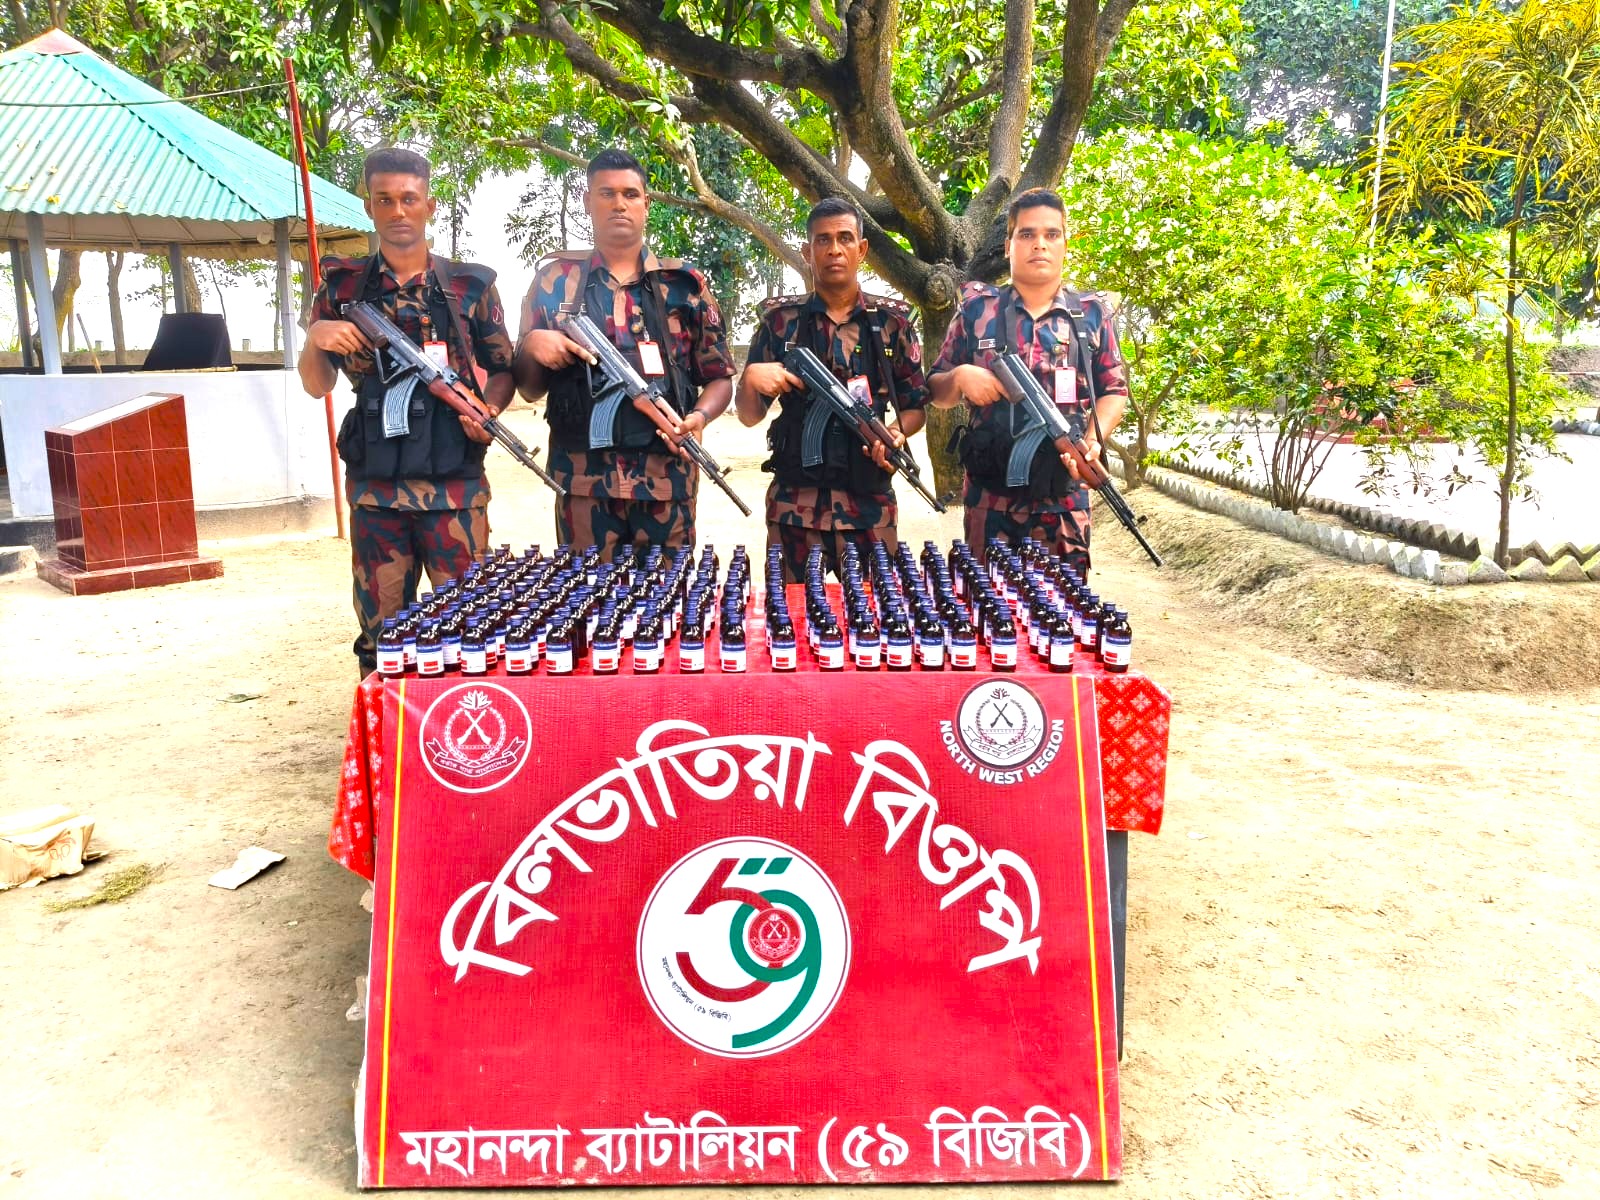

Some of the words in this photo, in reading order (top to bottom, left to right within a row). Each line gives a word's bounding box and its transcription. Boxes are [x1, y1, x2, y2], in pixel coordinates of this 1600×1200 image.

[940, 719, 976, 774] NORTH
[978, 766, 1024, 784] WEST
[1025, 719, 1064, 777] REGION
[440, 719, 832, 983] বিলভাতিয়া
[843, 739, 1041, 976] বিওপি
[399, 1124, 571, 1178] মহানন্দা
[581, 1110, 802, 1174] ব্যাটালিয়ন
[817, 1116, 909, 1182] (৫৯
[923, 1105, 1092, 1178] বিজিবি)
